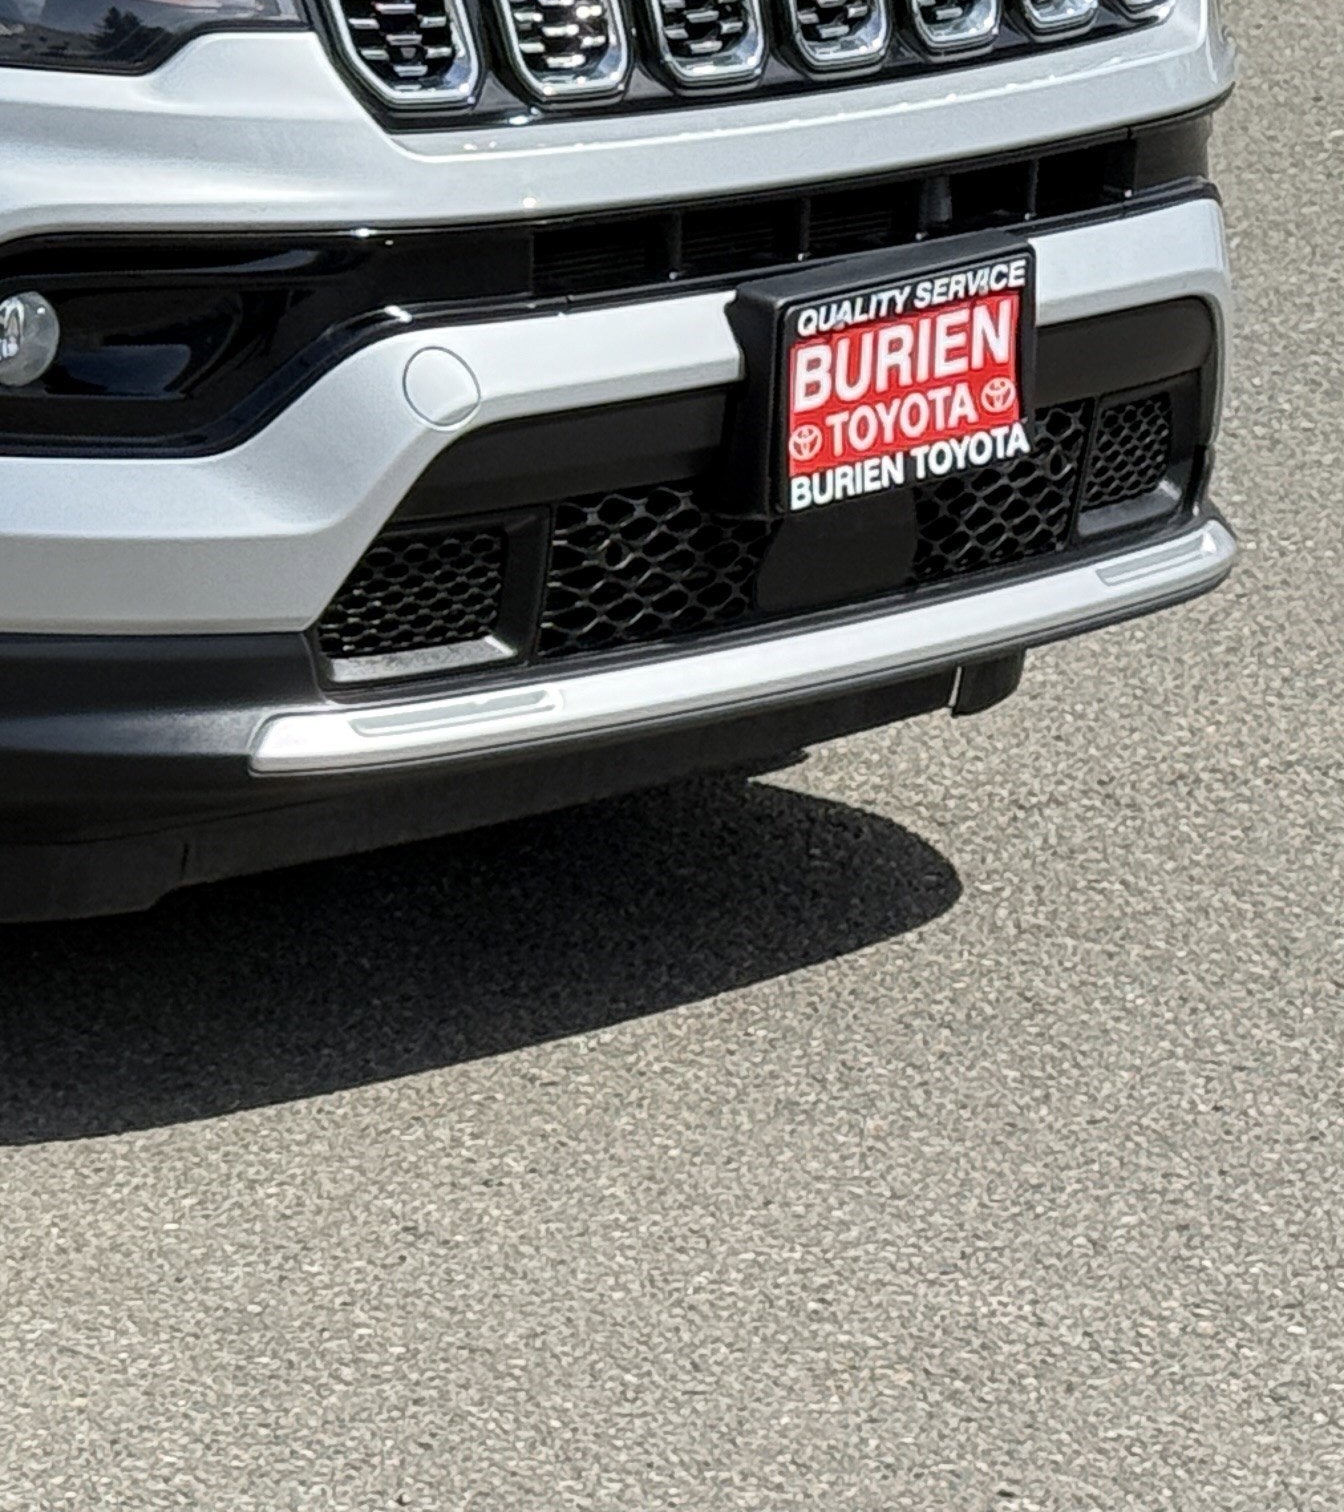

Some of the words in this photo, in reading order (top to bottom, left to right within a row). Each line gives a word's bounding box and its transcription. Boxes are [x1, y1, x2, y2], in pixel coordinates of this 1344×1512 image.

[797, 286, 912, 337] QUALITY
[913, 259, 1027, 310] SERVICE
[792, 299, 1013, 414] BURIEN
[825, 382, 980, 458] TOYOTA
[789, 451, 905, 511] BURIEN
[911, 419, 1032, 479] TOYOTA
